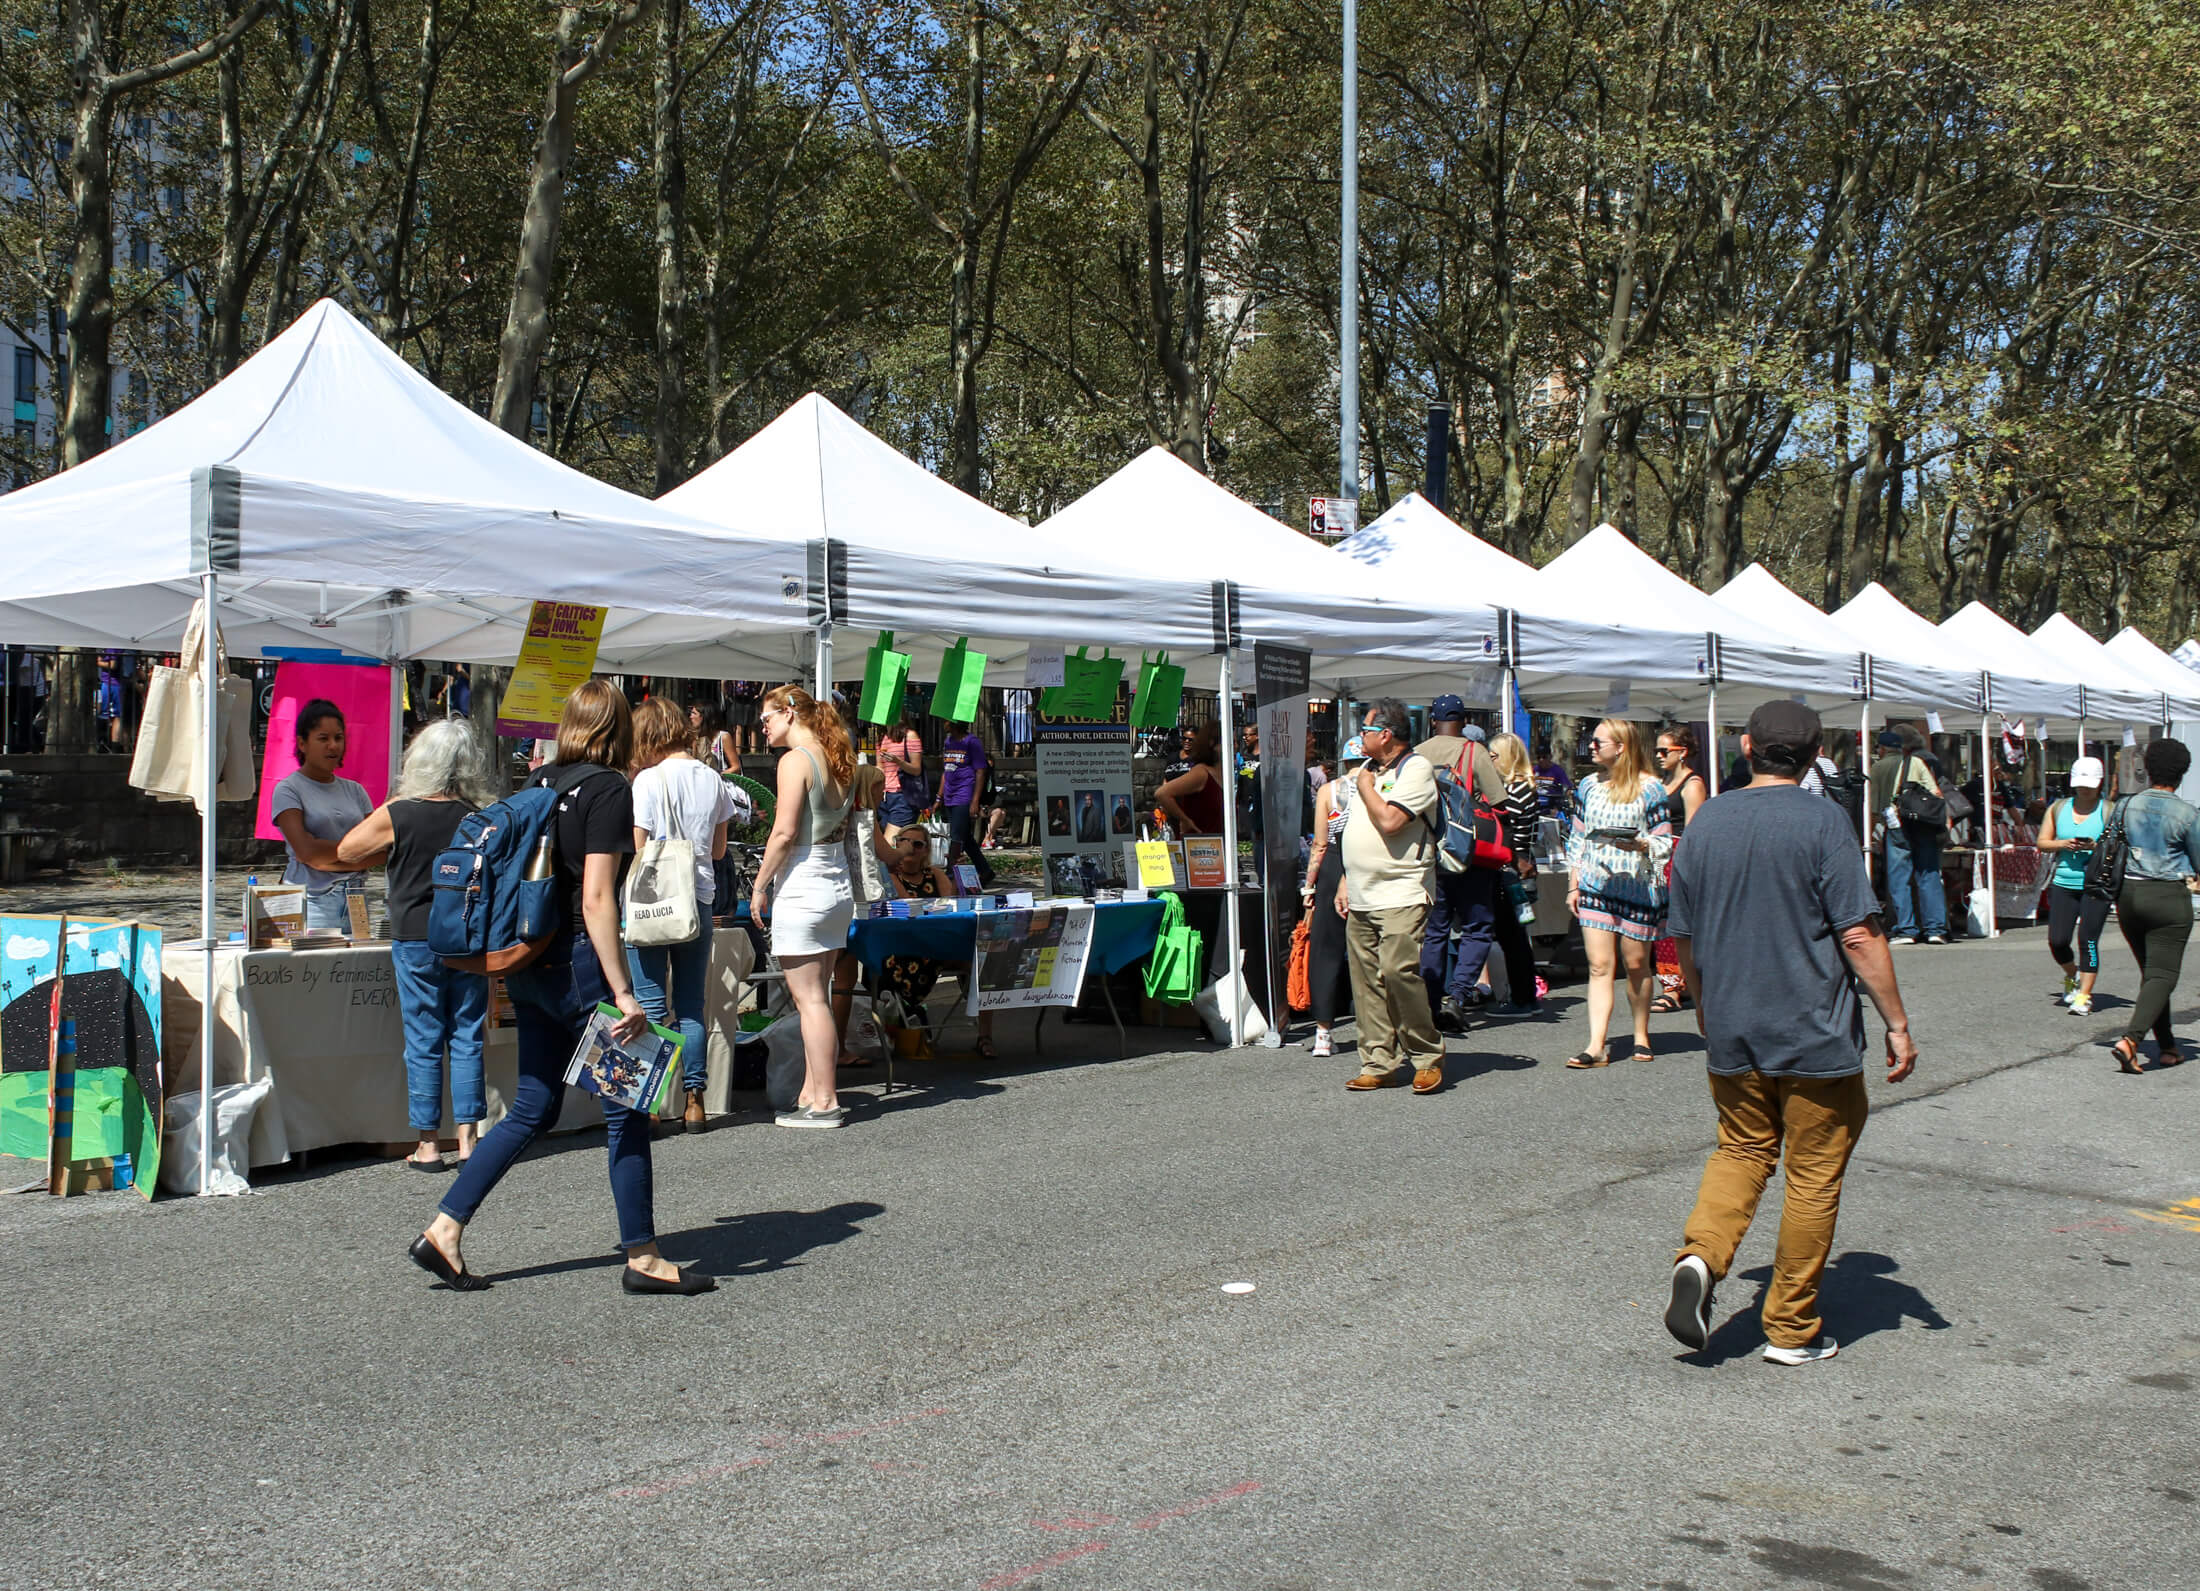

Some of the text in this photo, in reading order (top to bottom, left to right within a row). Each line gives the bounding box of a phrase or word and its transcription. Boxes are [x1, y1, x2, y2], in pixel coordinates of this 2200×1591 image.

[555, 604, 597, 621] CRITICS
[1040, 732, 1128, 740] AUTHOR, POET, DETECTIVE
[634, 905, 674, 920] READ LUCIA
[247, 960, 392, 992] Books by feminists
